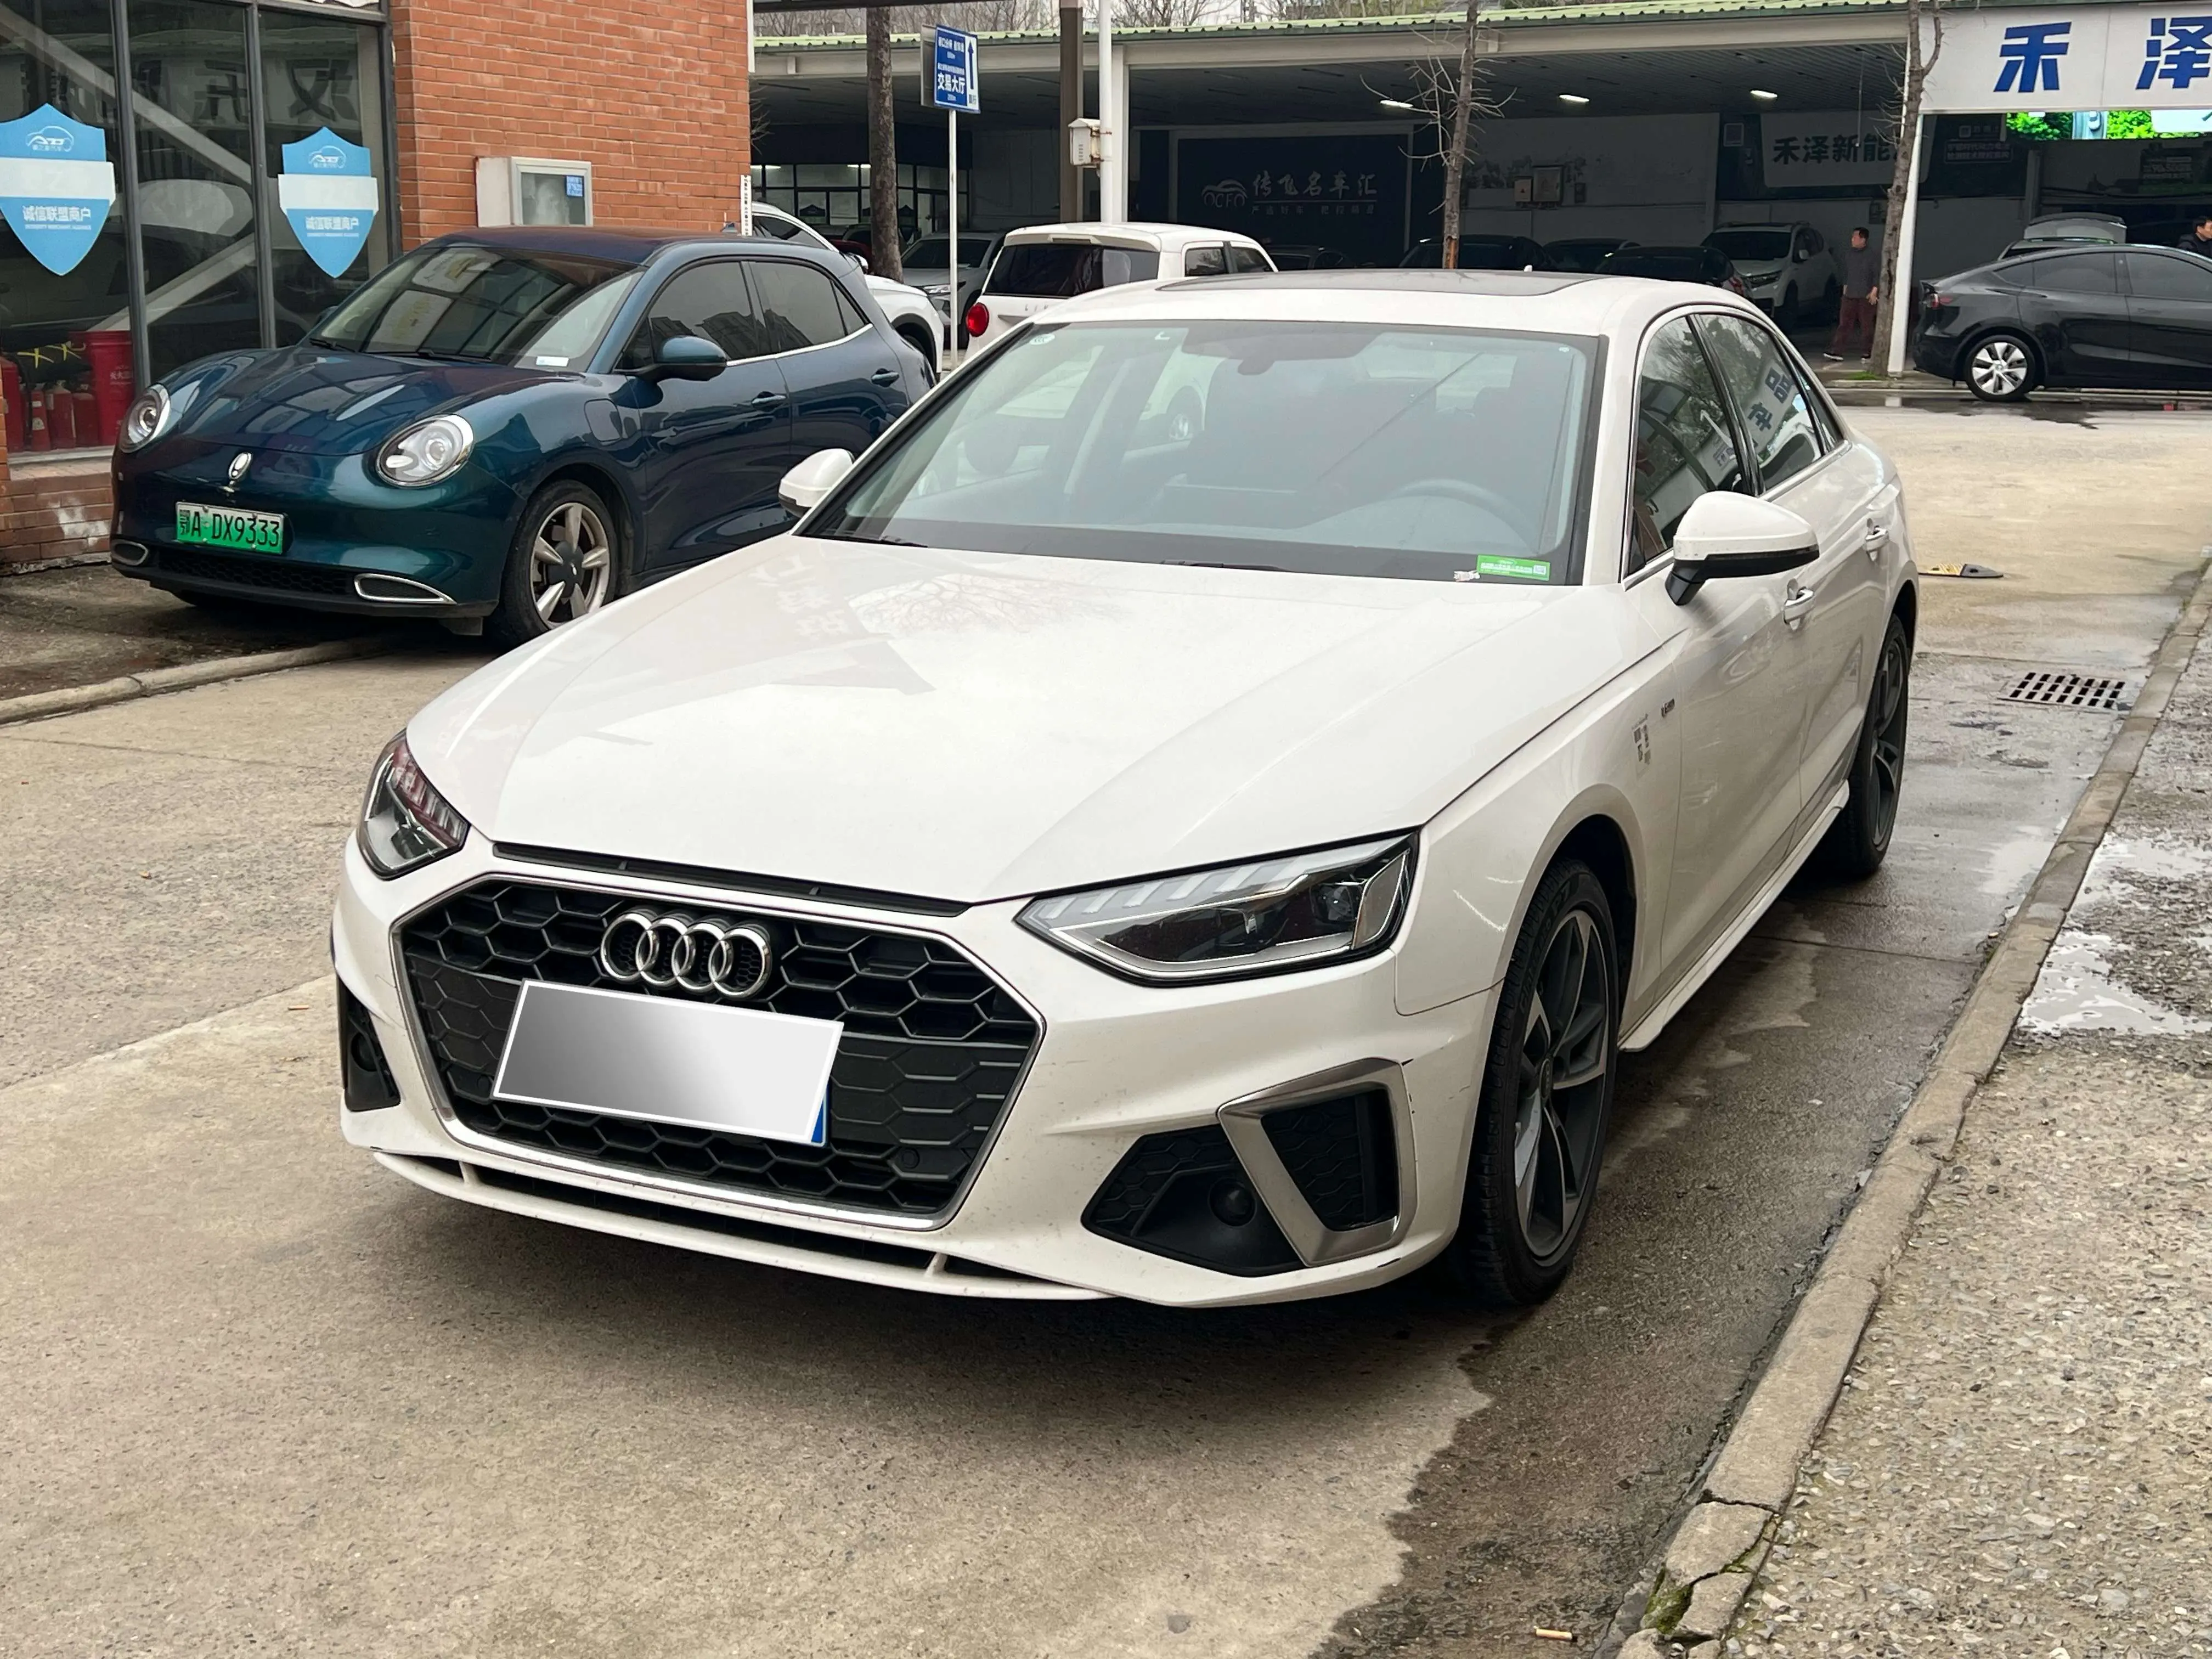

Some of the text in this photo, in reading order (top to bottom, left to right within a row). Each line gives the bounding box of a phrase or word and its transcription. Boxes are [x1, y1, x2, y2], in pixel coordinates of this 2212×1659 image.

[1993, 16, 2212, 93] 禾泽
[938, 72, 966, 94] 交易大厅
[1773, 133, 1898, 165] 禾泽新能
[22, 206, 91, 221] 诚信联盟商户
[211, 513, 280, 547] DX9333
